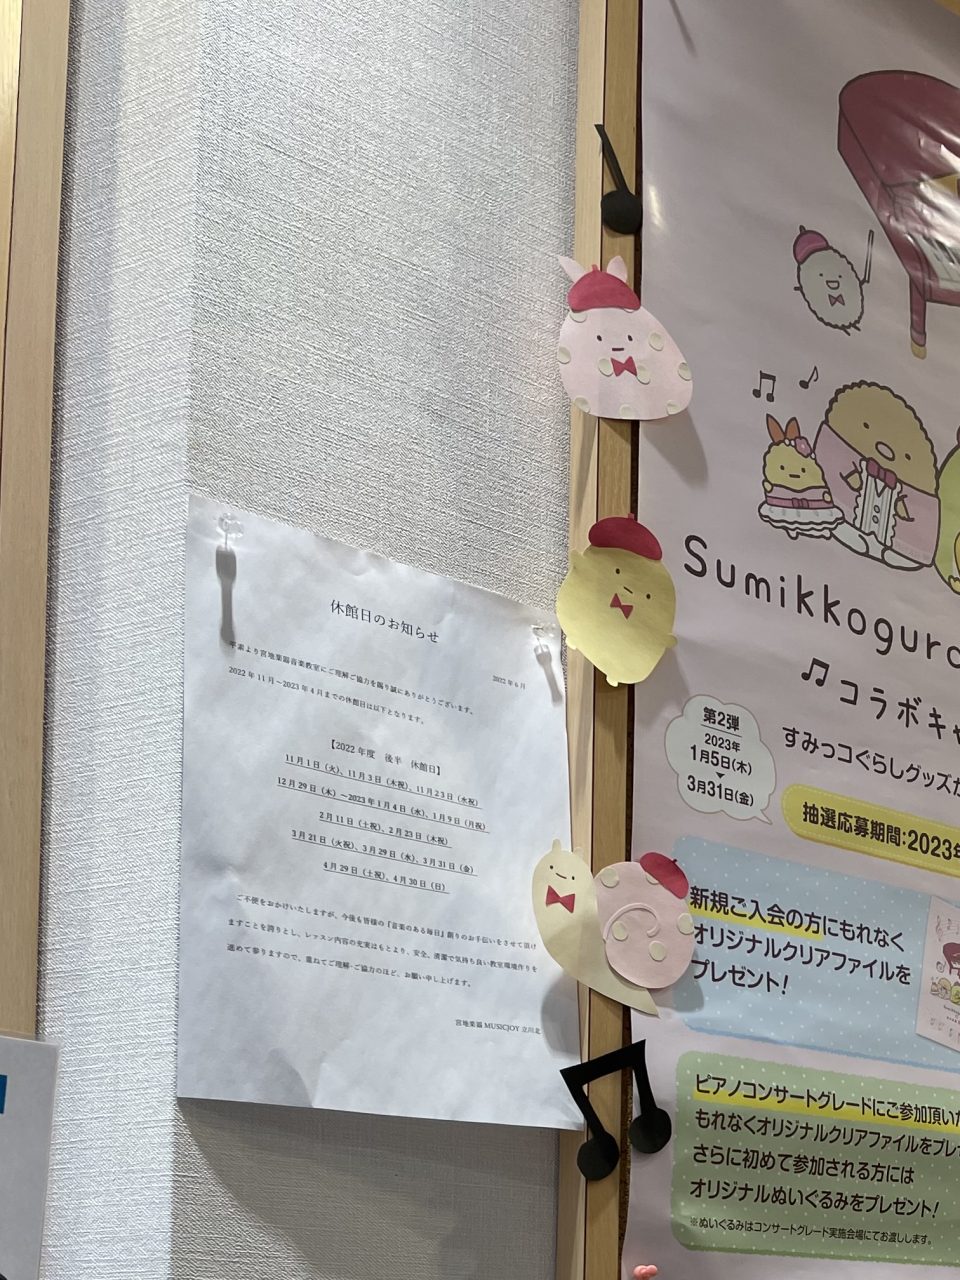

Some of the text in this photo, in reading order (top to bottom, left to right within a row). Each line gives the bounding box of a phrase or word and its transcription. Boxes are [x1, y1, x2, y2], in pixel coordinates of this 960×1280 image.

[331, 599, 439, 643] 休館日のお知らせ
[703, 706, 740, 732] 第2弾
[690, 744, 752, 776] 1月5日(木)
[704, 733, 741, 753] 2023年
[687, 775, 754, 807] 3月31日(金)
[689, 886, 905, 952] 新規ご入会の方にもれなく
[693, 922, 911, 985] オリジナルクリアファイルを
[691, 959, 789, 995] プレゼント!
[693, 1145, 914, 1184] さらに初めて参加される方には
[690, 1179, 940, 1219] オリジナルぬいぐるみをプレゼント!
